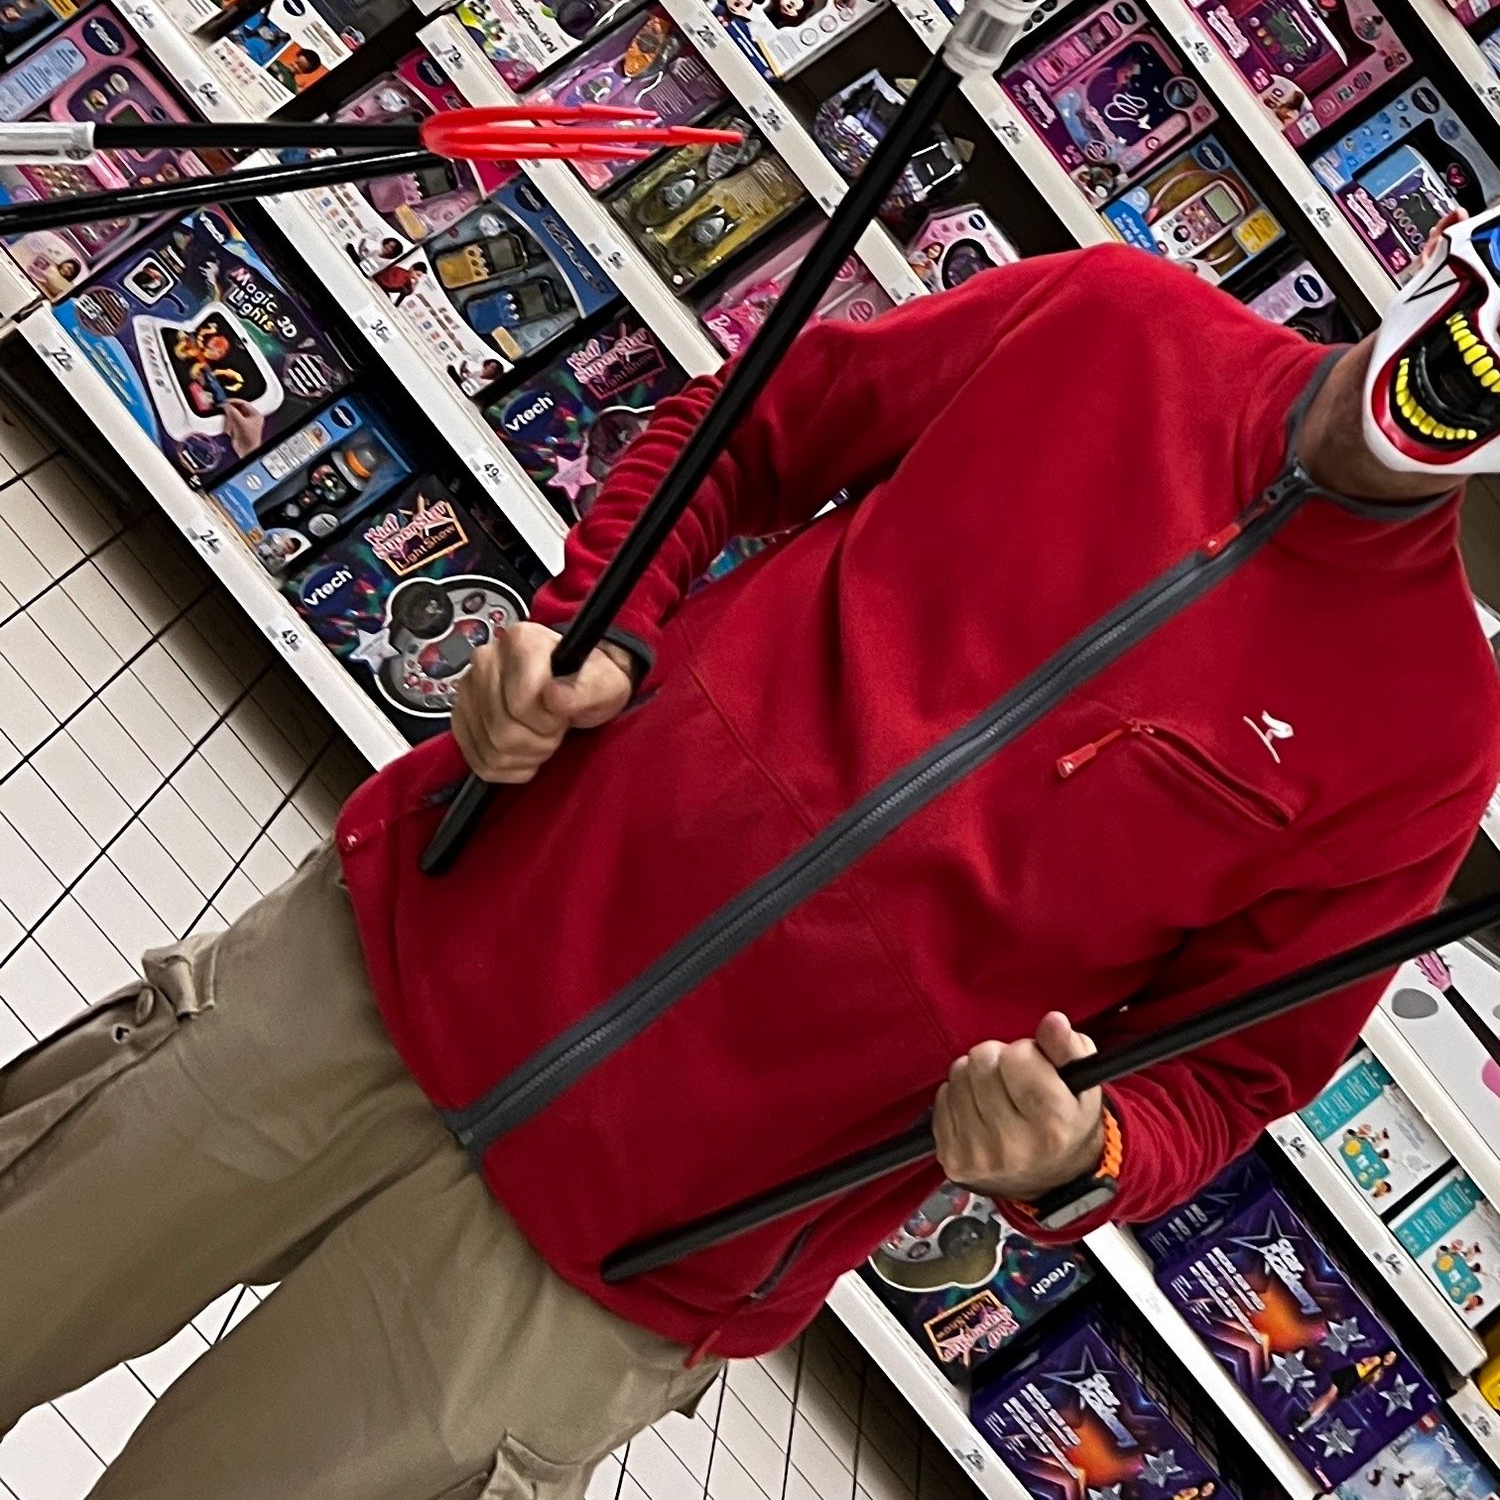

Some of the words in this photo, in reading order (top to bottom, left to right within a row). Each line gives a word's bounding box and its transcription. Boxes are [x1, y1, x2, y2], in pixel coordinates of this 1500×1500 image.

[538, 32, 559, 55] Uni
[224, 286, 276, 335] Lights
[229, 265, 280, 316] Magic
[273, 314, 299, 340] 3D
[505, 392, 554, 434] vtech
[303, 566, 353, 609] vtech
[1273, 1235, 1307, 1277] Star
[1029, 1259, 1077, 1298] vtech
[1260, 1242, 1323, 1320] Academy
[1088, 1371, 1123, 1409] Star
[1073, 1377, 1138, 1453] Academy
